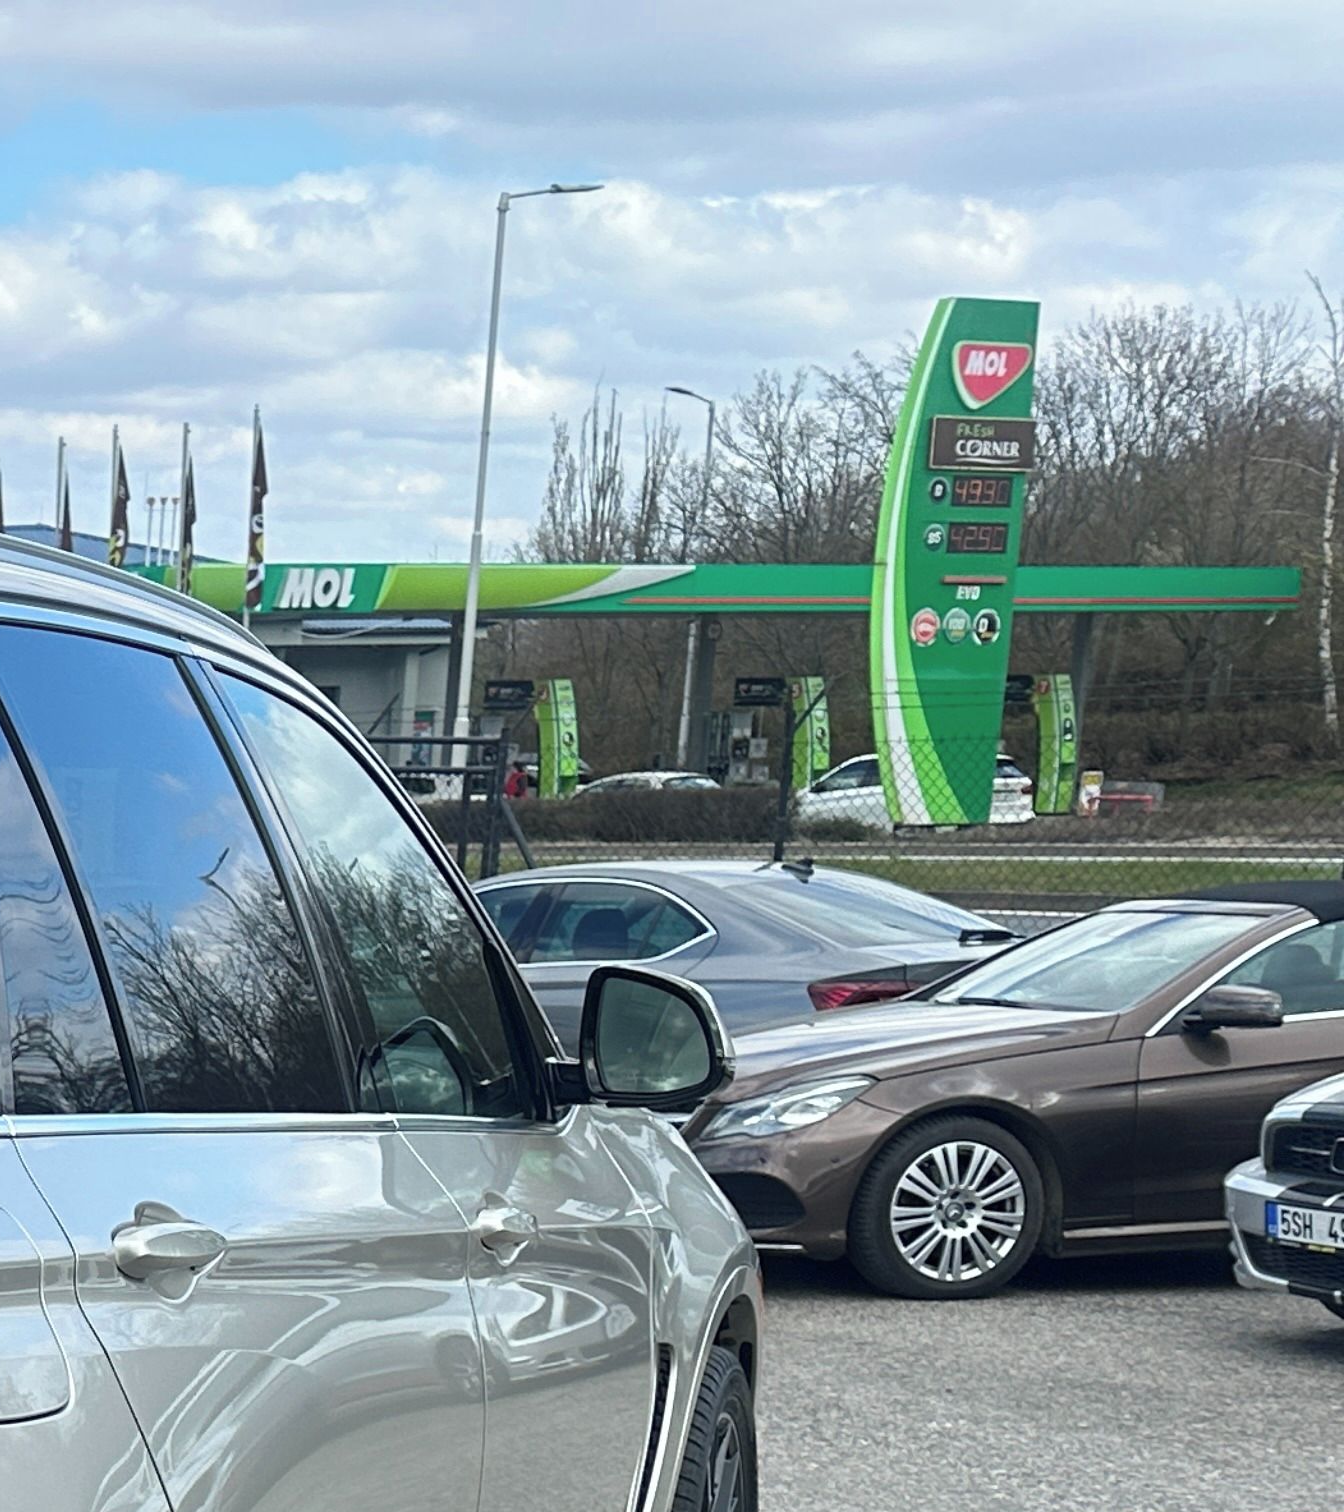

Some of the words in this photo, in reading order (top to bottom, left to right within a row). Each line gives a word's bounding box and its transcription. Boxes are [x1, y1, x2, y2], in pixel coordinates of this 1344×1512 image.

[964, 350, 1008, 378] MOL
[955, 439, 1020, 457] CORNER
[278, 567, 356, 609] MOL
[1280, 1209, 1313, 1240] 5SH
